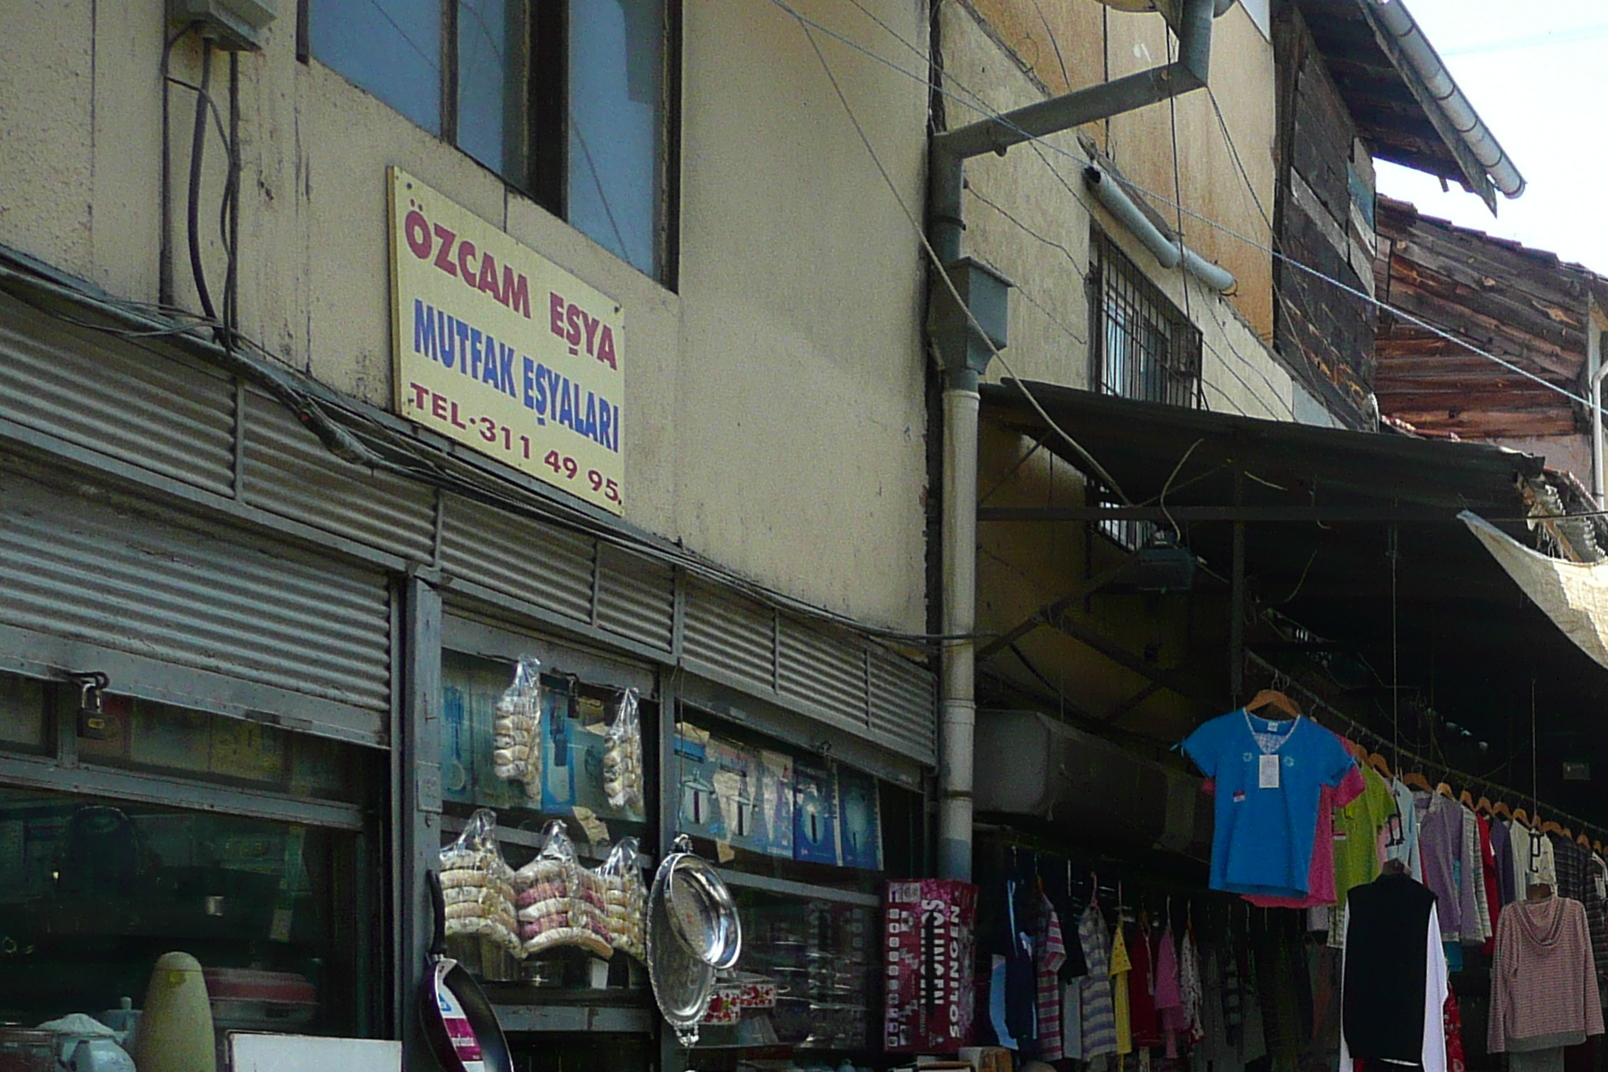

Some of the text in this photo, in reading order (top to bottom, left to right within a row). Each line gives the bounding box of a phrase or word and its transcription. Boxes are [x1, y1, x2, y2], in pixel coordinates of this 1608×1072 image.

[405, 198, 617, 371] ÖZCAM EŞYA
[414, 299, 619, 453] MUTFAK EŞYALARI
[544, 450, 578, 480] 49
[949, 905, 961, 1038] SOLINGEN
